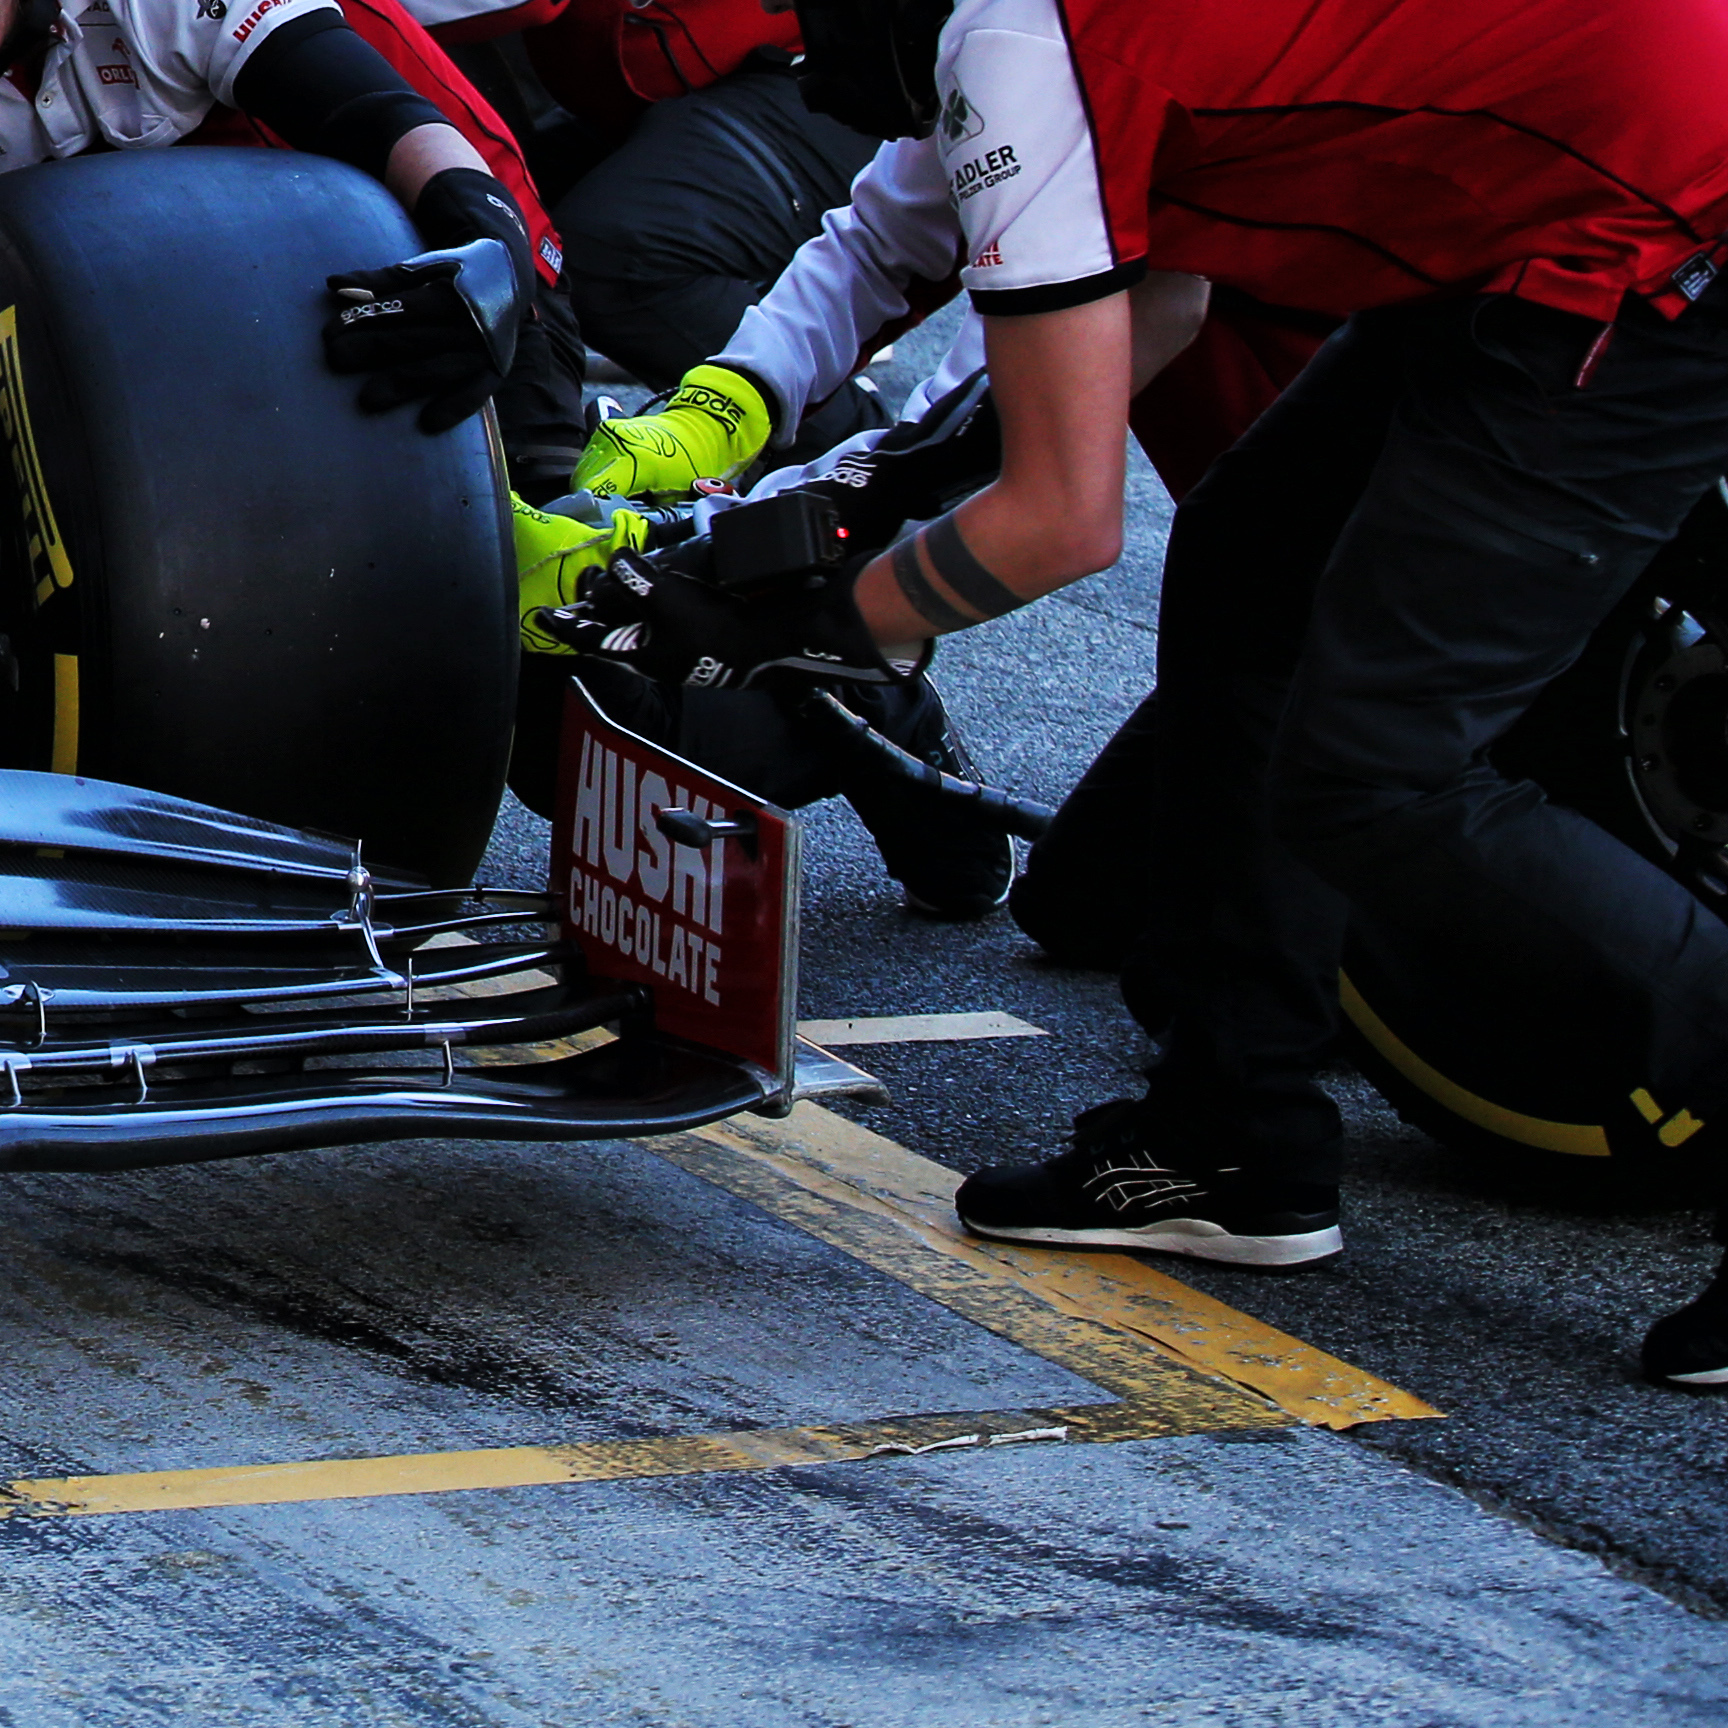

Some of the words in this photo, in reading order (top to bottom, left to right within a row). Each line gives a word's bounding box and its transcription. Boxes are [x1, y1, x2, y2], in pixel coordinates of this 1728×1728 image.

[955, 145, 1017, 190] ADLER
[984, 165, 1021, 188] GROUP
[341, 300, 403, 321] sparco
[573, 731, 726, 936] HUSKI
[569, 867, 721, 1008] CHOCOLATE
